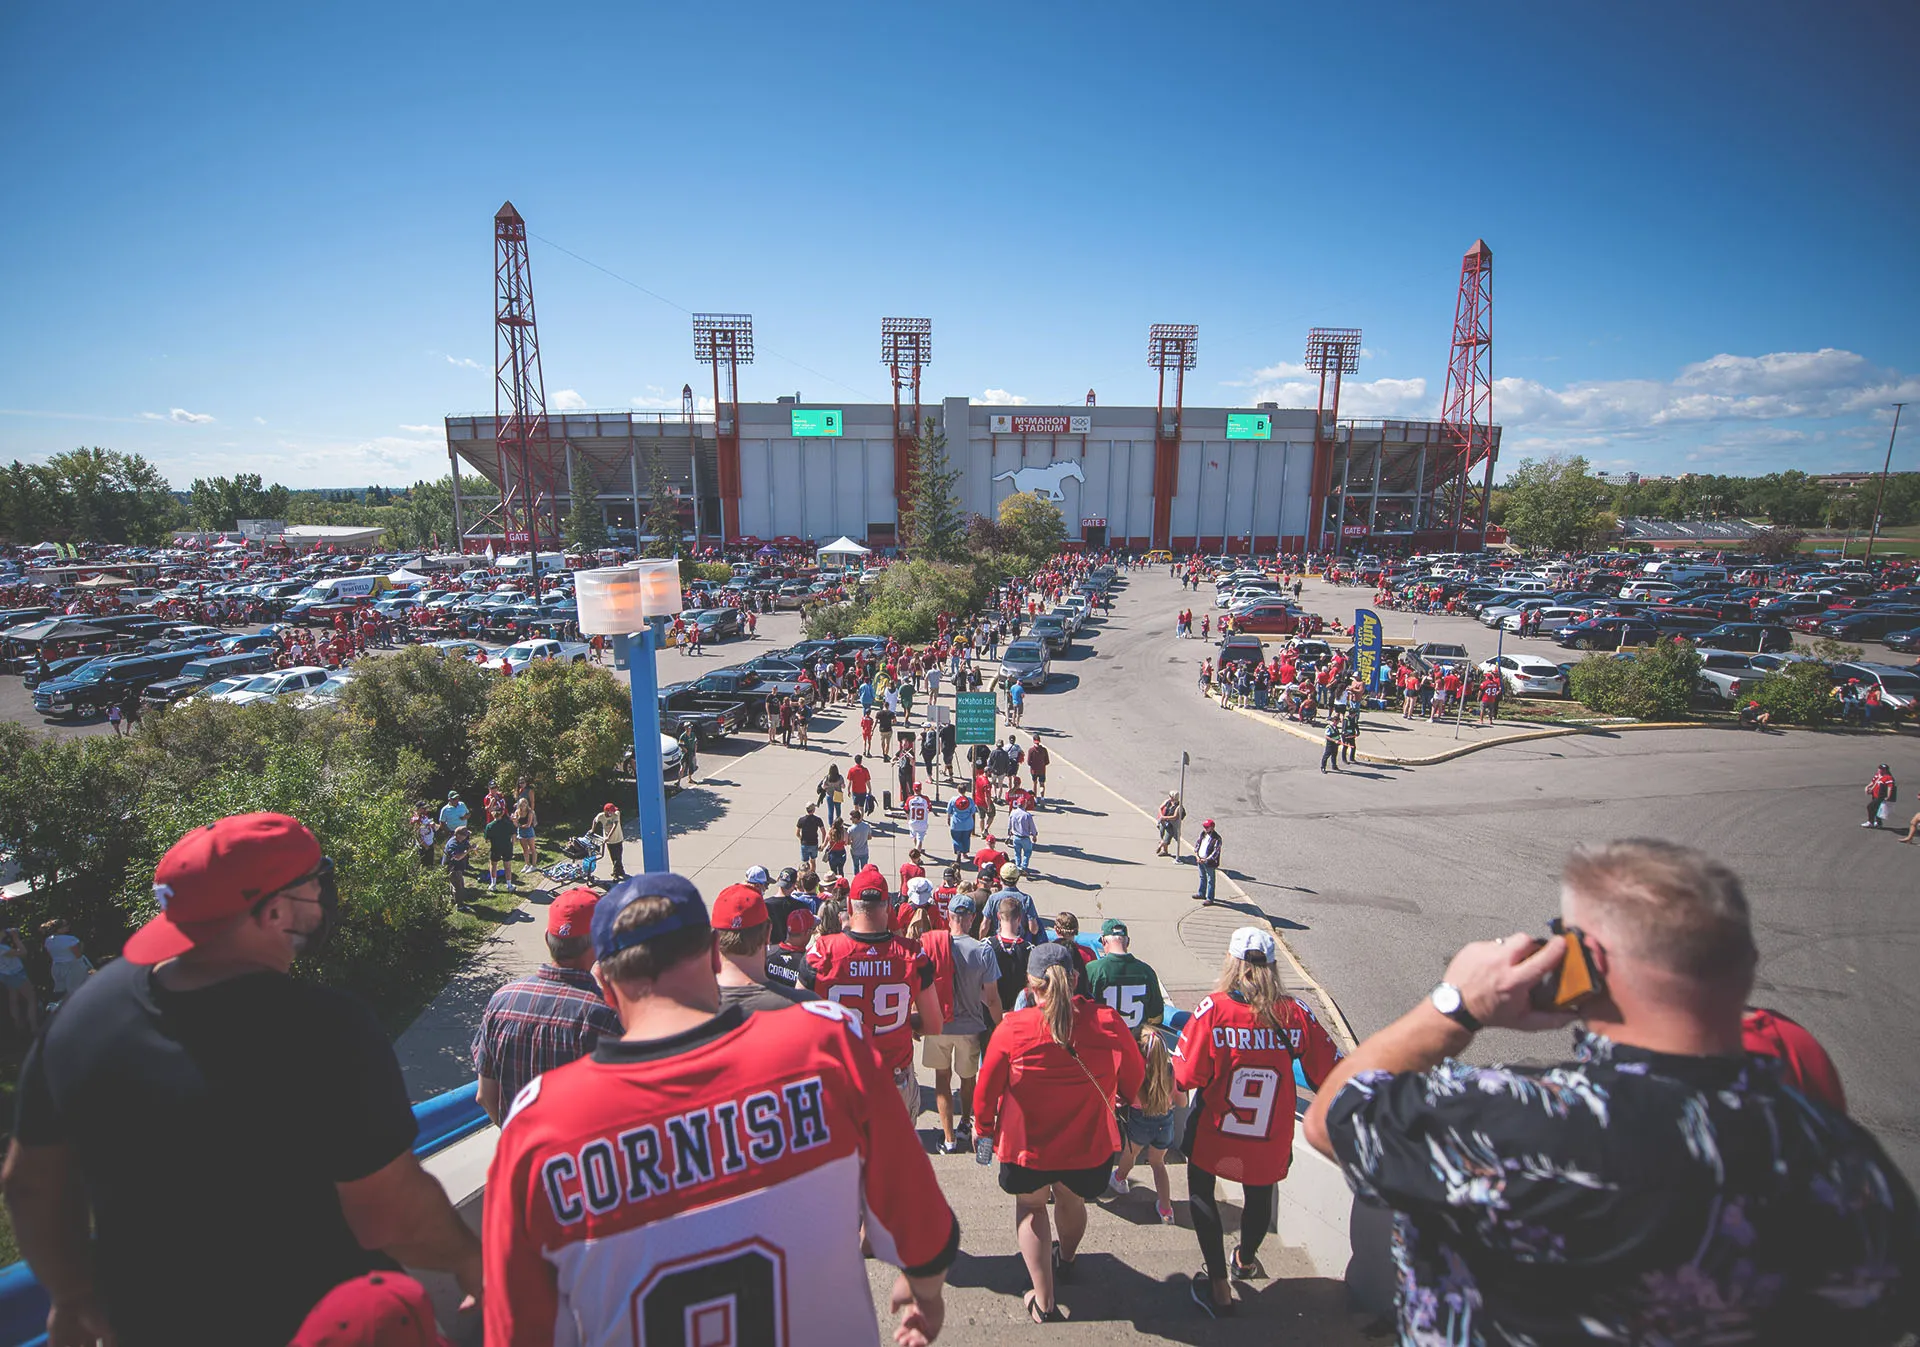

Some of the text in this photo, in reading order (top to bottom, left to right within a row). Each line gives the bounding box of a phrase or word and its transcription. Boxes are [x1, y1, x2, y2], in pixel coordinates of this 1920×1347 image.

[826, 416, 834, 426] B
[1257, 420, 1265, 430] B
[1018, 424, 1064, 432] STADIUM
[1082, 519, 1101, 527] GATE
[509, 533, 529, 541] GATE
[1361, 614, 1377, 685] Auto Value
[1485, 687, 1497, 696] 49
[958, 697, 995, 706] McMahon East
[911, 807, 925, 820] 19
[768, 963, 799, 981] CORNISH
[850, 960, 892, 977] SMITH
[1103, 984, 1146, 1028] 15
[1194, 996, 1214, 1019] 9
[1219, 1065, 1281, 1140] 9
[541, 1075, 830, 1225] CORNISH
